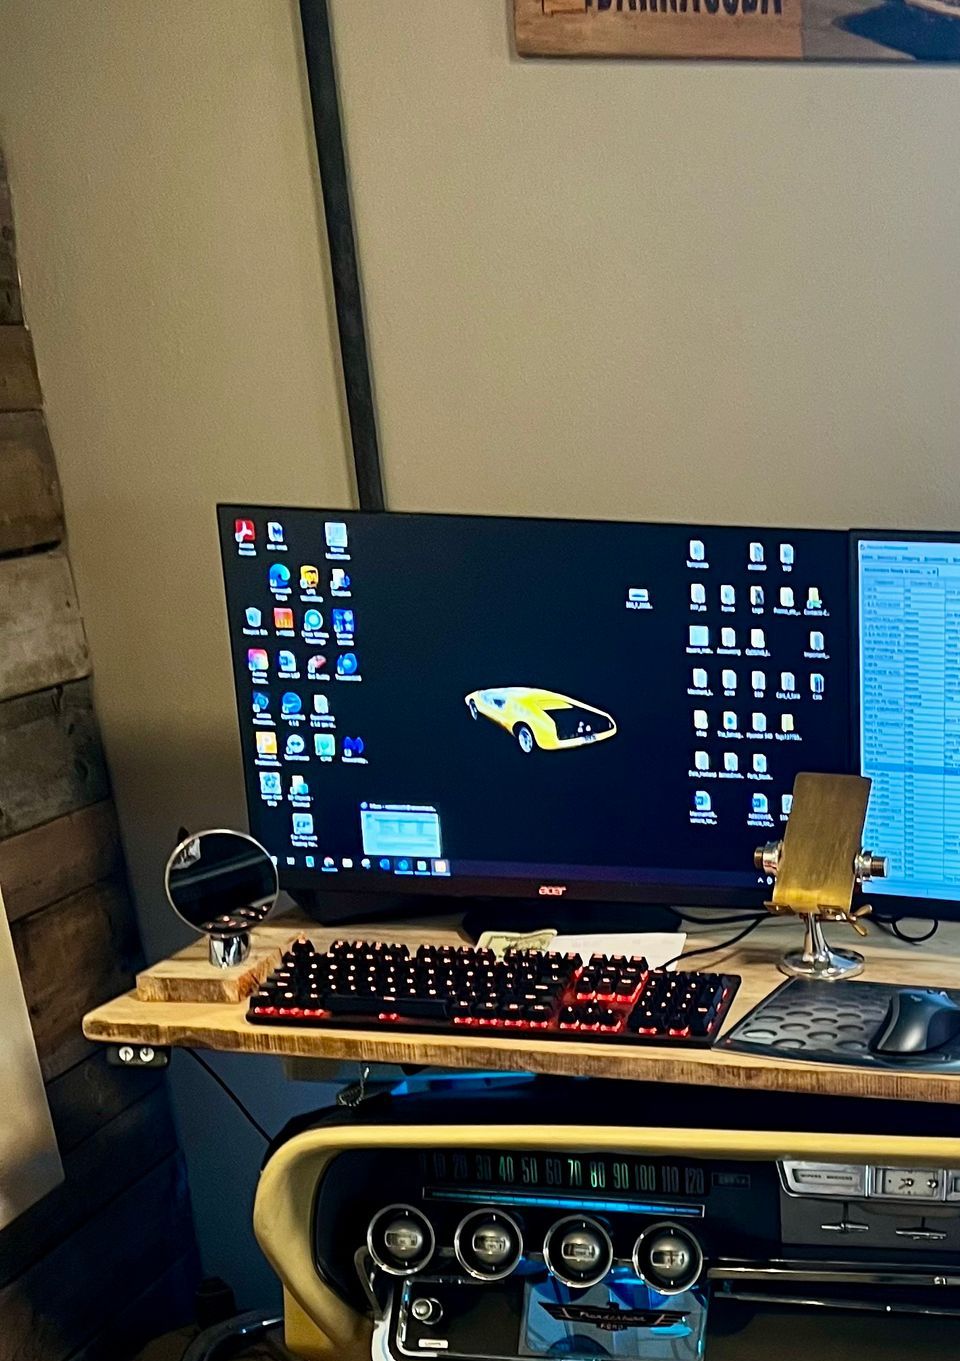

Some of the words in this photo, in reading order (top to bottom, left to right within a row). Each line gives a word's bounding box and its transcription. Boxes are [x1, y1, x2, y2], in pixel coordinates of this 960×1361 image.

[538, 886, 567, 896] acer
[499, 1155, 515, 1183] 40
[521, 1157, 538, 1184] 50
[567, 1158, 583, 1186] 70
[589, 1160, 606, 1189] 80
[612, 1162, 630, 1190] 90
